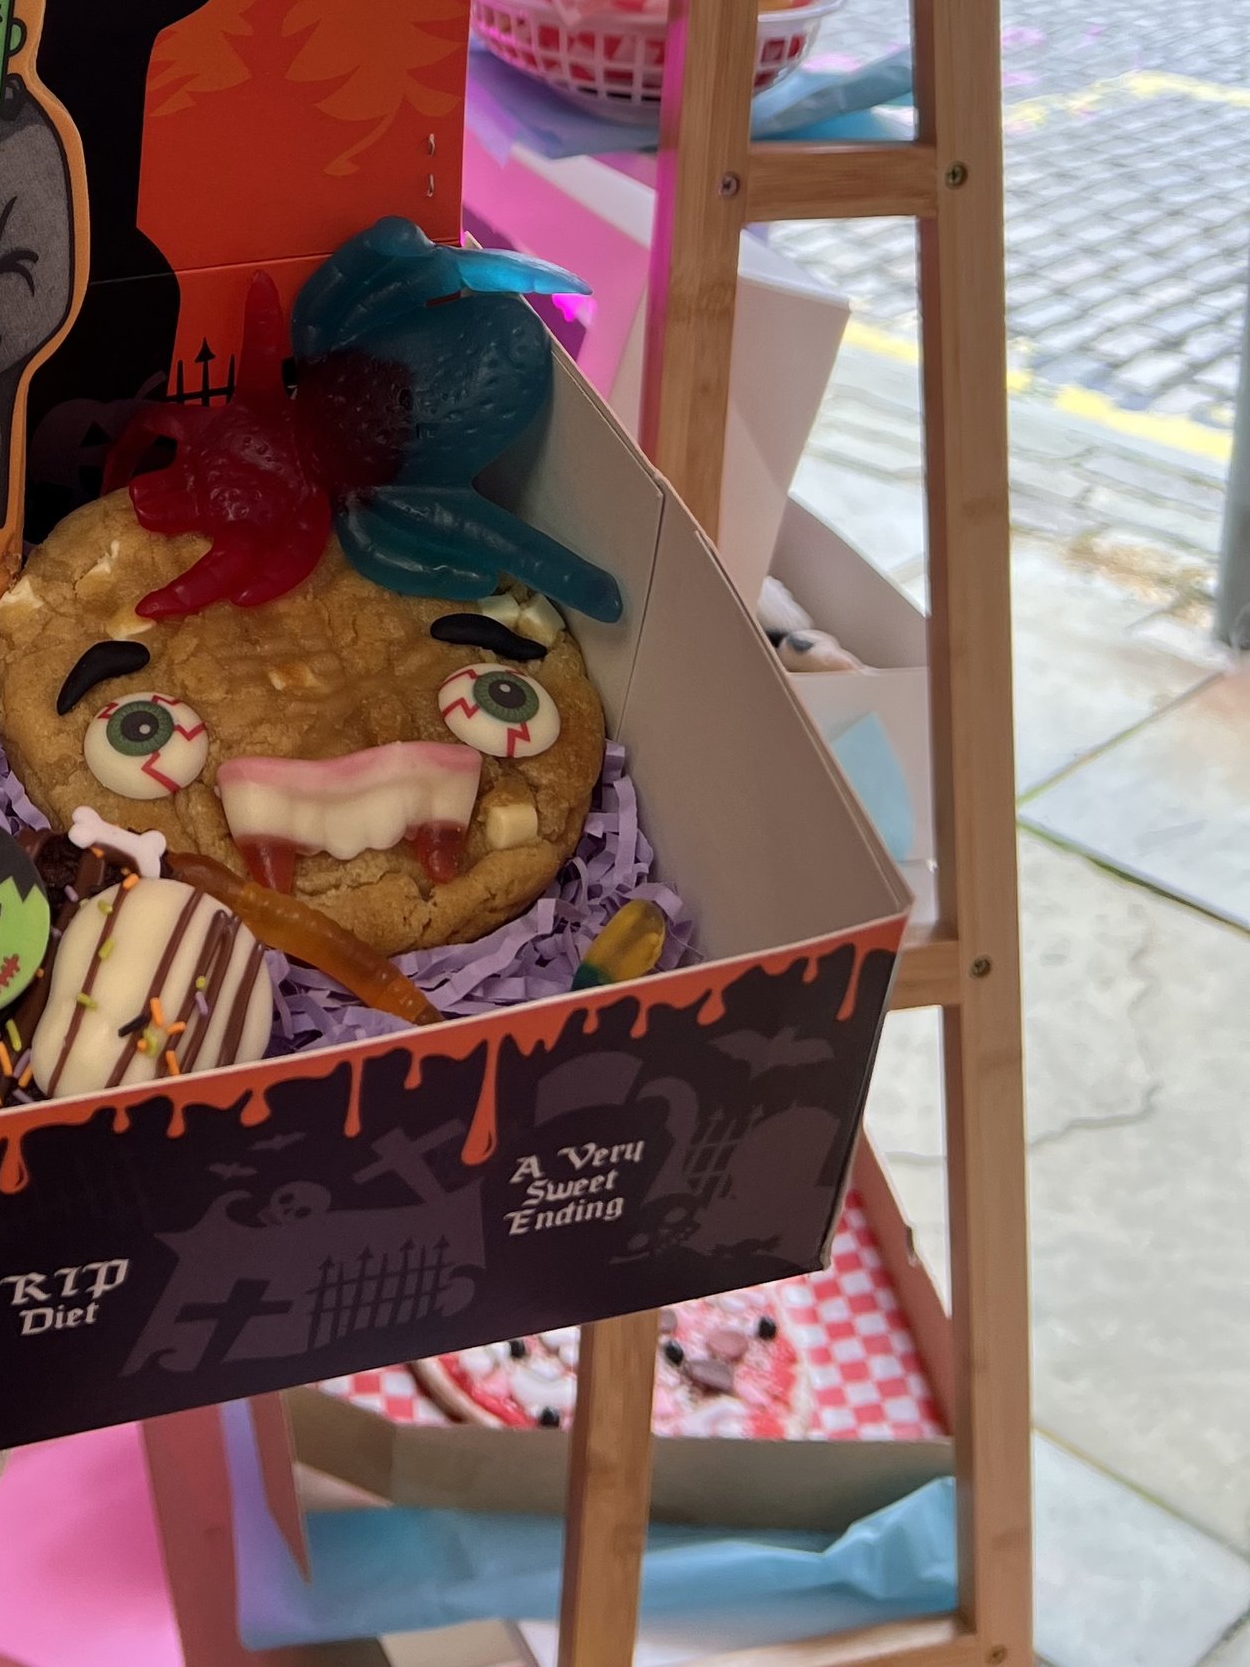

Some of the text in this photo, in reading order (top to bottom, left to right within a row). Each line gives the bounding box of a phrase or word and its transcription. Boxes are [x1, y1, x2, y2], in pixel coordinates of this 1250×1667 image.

[509, 1139, 646, 1184] A Very
[522, 1169, 617, 1208] Sweet
[502, 1196, 626, 1236] Ending
[0, 1258, 130, 1307] RIP
[18, 1301, 100, 1336] Diet
